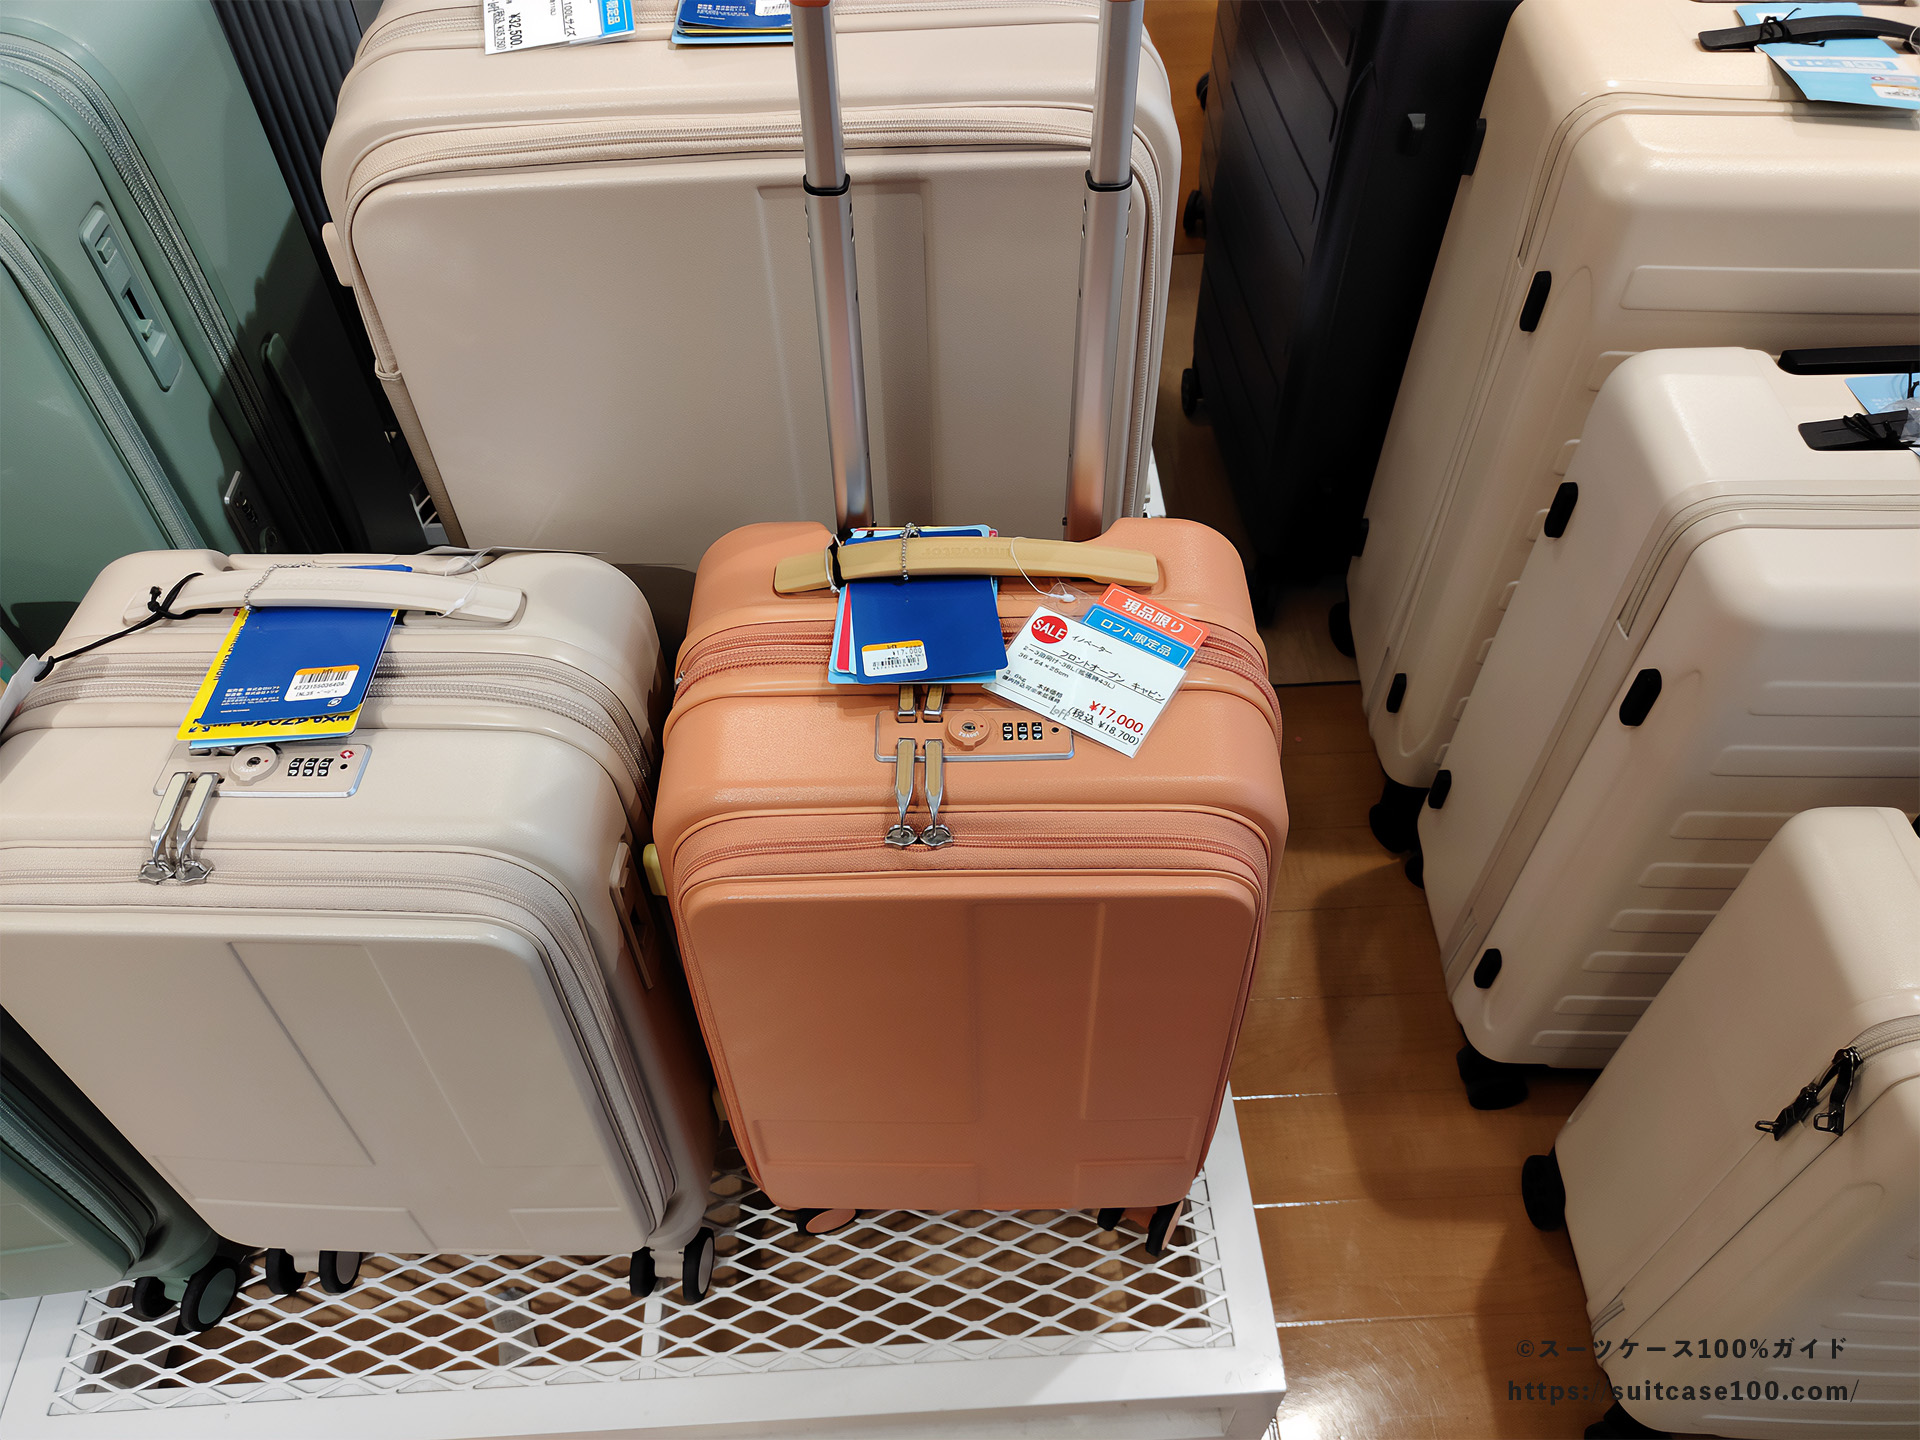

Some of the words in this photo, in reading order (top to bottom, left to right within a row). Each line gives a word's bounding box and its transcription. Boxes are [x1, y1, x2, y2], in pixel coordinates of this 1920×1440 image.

[1122, 597, 1185, 634] 現品限り
[1032, 619, 1068, 640] SALE
[1100, 618, 1171, 657] ロフト限定品
[1072, 634, 1112, 655] イノベーター
[1098, 720, 1140, 746] ¥18,700)
